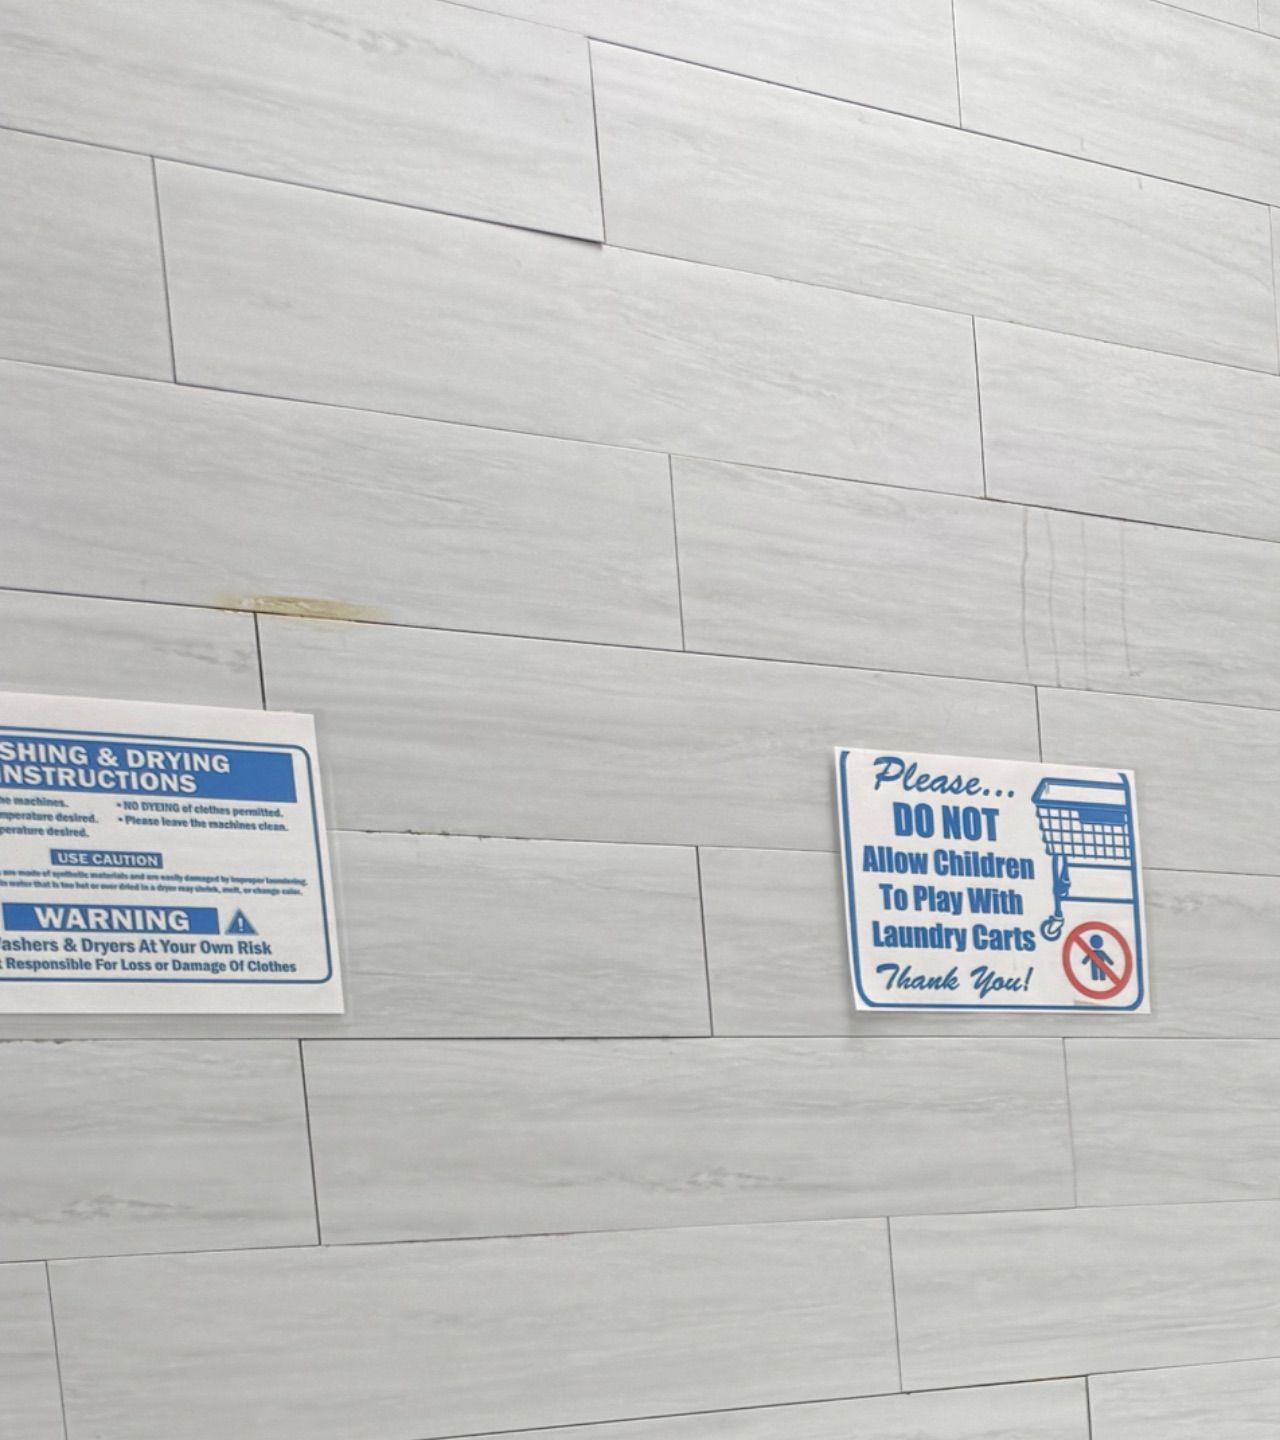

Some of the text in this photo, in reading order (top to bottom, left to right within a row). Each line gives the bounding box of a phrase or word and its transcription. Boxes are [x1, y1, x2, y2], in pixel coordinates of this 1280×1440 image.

[0, 741, 231, 773] SHING & DRYING
[874, 755, 1015, 798] Please...
[56, 813, 99, 824] desired.
[123, 801, 284, 818] NO DYEING of clothes permitted.
[893, 801, 999, 842] DO NOT
[47, 826, 90, 838] desired.
[125, 815, 159, 826] Please
[161, 817, 188, 828] leave
[190, 818, 206, 829] the
[208, 819, 256, 831] machines
[57, 852, 158, 867] USE CAUTION
[862, 845, 1035, 880] Allow Children
[879, 883, 1024, 917] To Play With
[33, 906, 190, 931] WARNING
[0, 936, 273, 956] ashers & Dryers At Your Own Risk
[872, 920, 1037, 952] Laundry Carts
[5, 956, 93, 972] Responsible
[95, 958, 118, 971] For
[121, 958, 152, 972] Loss
[155, 961, 169, 971] or
[172, 959, 226, 975] Damage
[229, 960, 244, 972] Of
[247, 960, 297, 973] Clothes
[875, 962, 1034, 999] Thank You!
